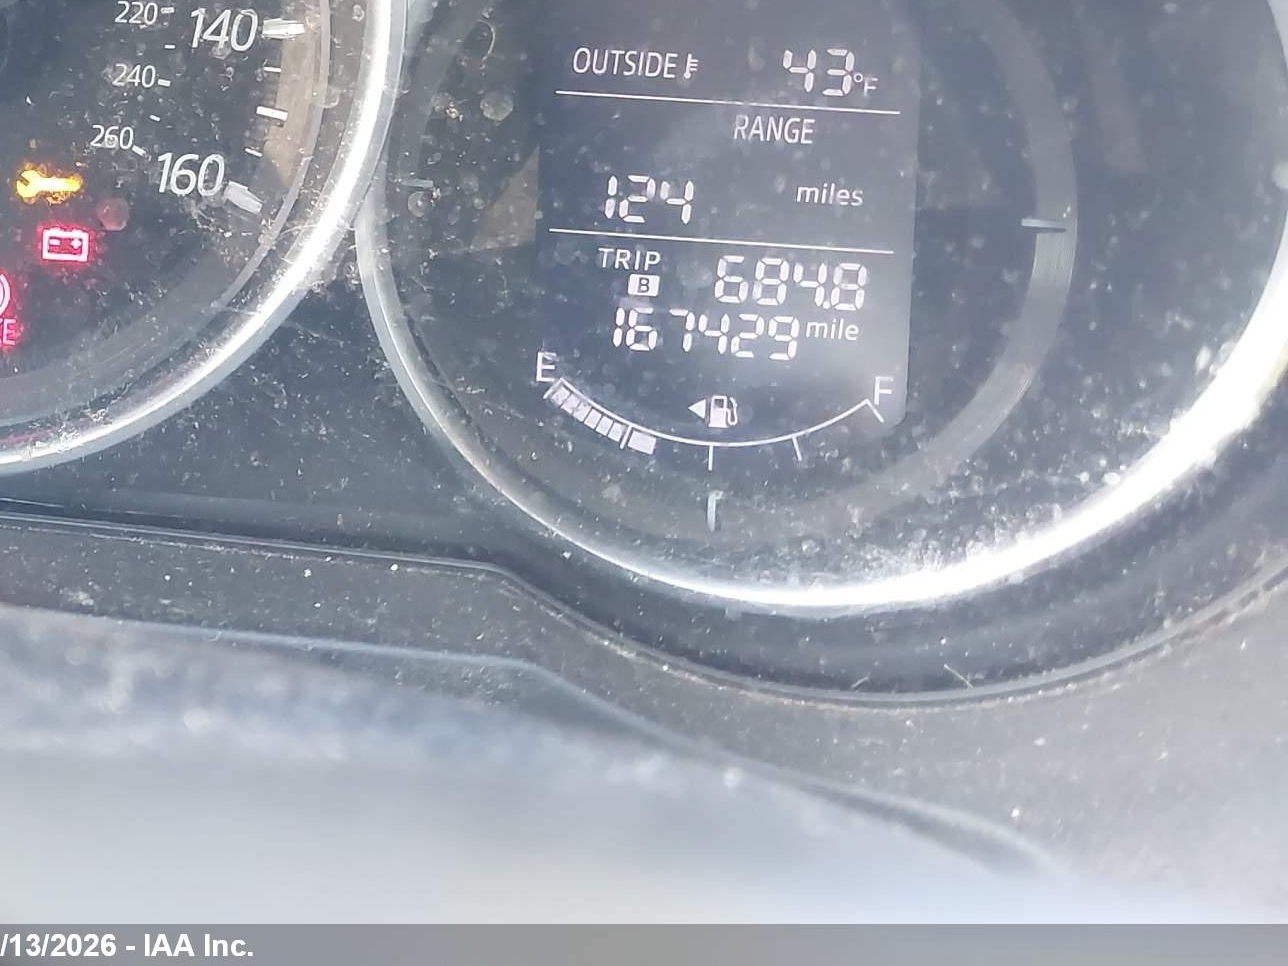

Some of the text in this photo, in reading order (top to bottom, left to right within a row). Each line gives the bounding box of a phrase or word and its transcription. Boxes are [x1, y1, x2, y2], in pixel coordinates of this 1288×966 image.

[114, 1, 158, 25] 220
[189, 8, 258, 52] 140
[112, 64, 156, 88] 240
[572, 47, 678, 79] OUTSIDE
[90, 125, 134, 150] 260
[733, 114, 816, 145] RANGE
[156, 152, 225, 196] 160
[604, 174, 864, 225] 124 miles
[598, 247, 661, 271] TRIP
[612, 306, 860, 361] 167429 mile
[535, 351, 557, 383] E
[873, 376, 894, 406] F
